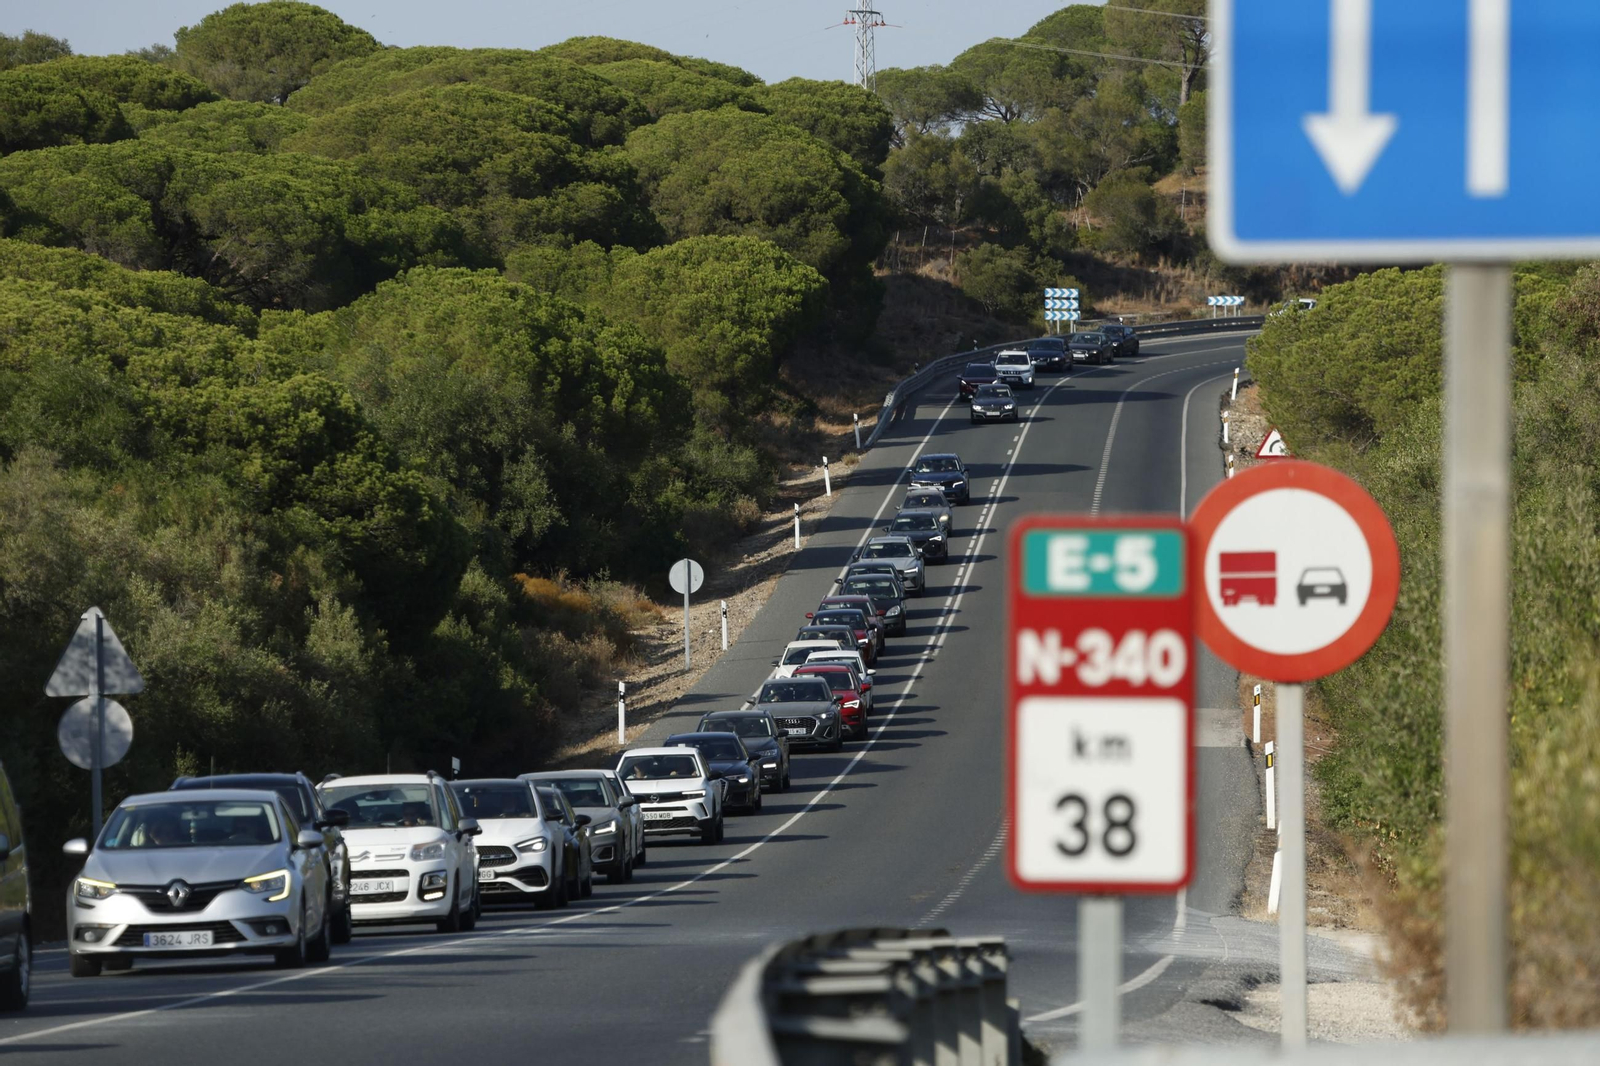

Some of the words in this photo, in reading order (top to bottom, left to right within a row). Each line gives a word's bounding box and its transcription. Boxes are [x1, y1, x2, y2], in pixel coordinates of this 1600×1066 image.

[1047, 533, 1158, 592] E-5
[1017, 627, 1187, 688] N-340
[1070, 721, 1133, 765] km
[1055, 792, 1137, 858] 38
[374, 881, 390, 891] JCX
[152, 933, 182, 946] 3624
[186, 933, 209, 945] JRS
